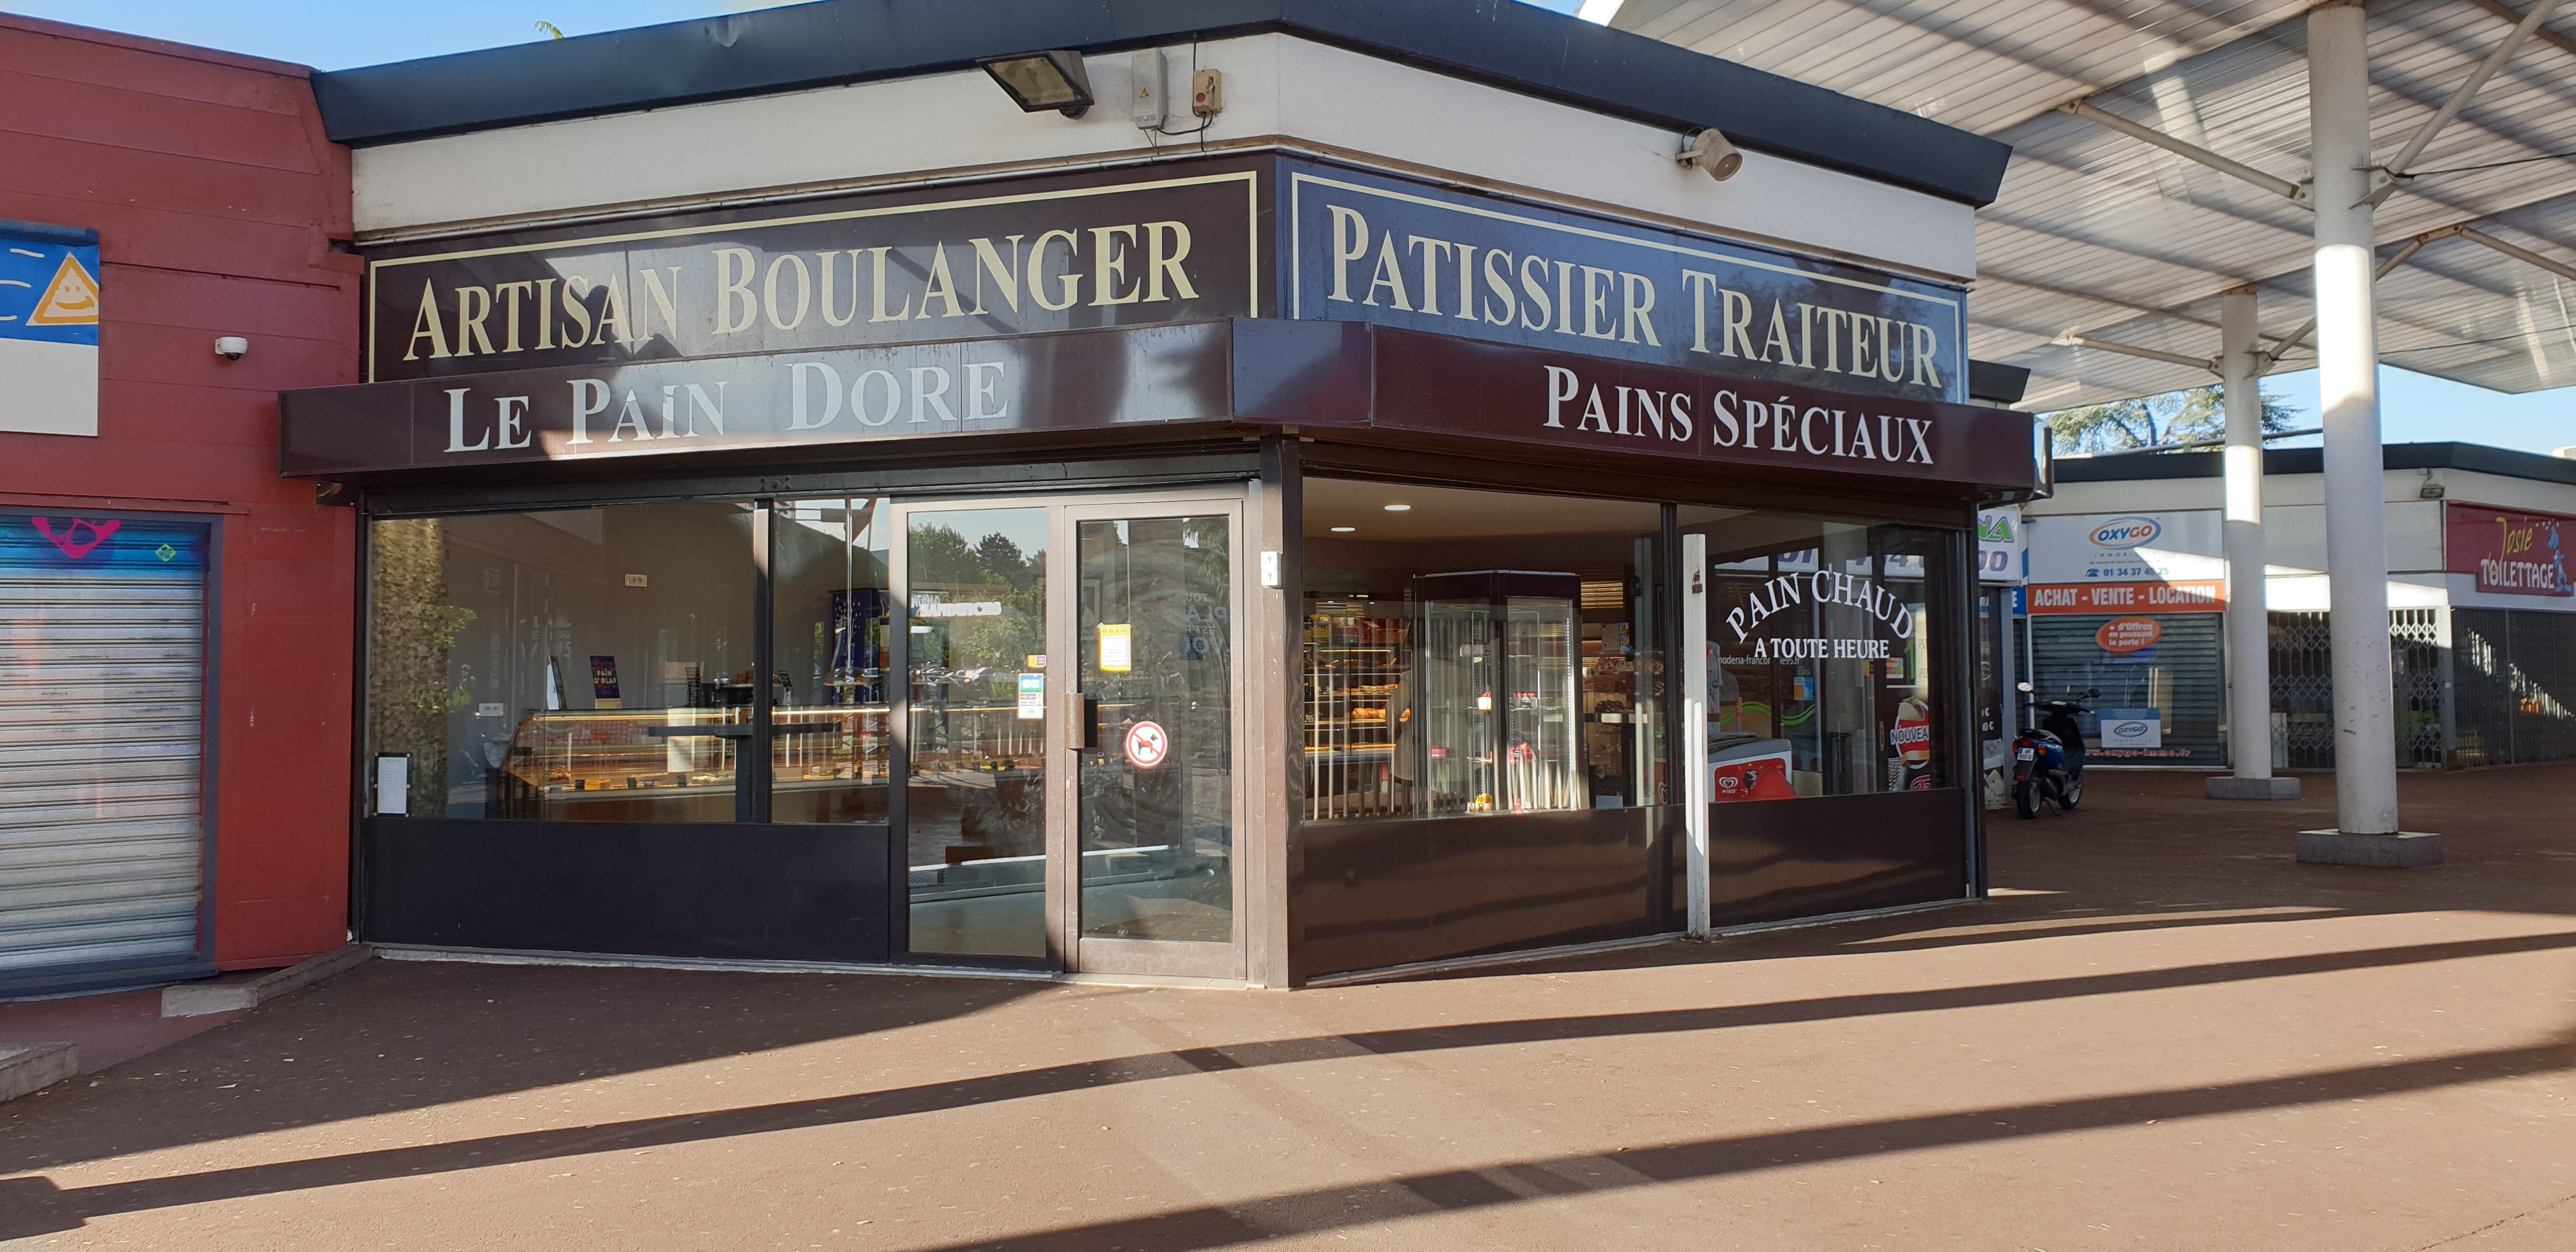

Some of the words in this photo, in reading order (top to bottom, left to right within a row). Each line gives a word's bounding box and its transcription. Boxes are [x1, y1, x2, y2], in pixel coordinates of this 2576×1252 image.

[403, 266, 682, 360] ARTISAN
[712, 220, 1199, 335] BOULANGER
[1326, 204, 1661, 347] PATISSIER
[1682, 269, 1942, 388] TRAITEUR
[443, 388, 532, 452] LE
[566, 378, 728, 445] PAIN
[786, 361, 1008, 431] DORE
[1543, 365, 1692, 443] PAINS
[1713, 390, 1934, 464] SPÉCIAUX
[2097, 525, 2152, 541] OXYGO
[2117, 568, 2128, 576] 34
[2131, 567, 2141, 576] 37
[2481, 559, 2554, 588] TOILETTAGE
[1726, 572, 1800, 644] PAIN
[1812, 570, 1913, 639] CHAUD
[2034, 589, 2078, 606] ACHAT
[2091, 587, 2134, 606] VENTE
[2149, 585, 2216, 604] LOCATION
[1754, 637, 1768, 658] A
[1770, 638, 1828, 658] TOUTE
[1834, 639, 1890, 659] HEURE
[1891, 726, 1929, 744] NOUVEA
